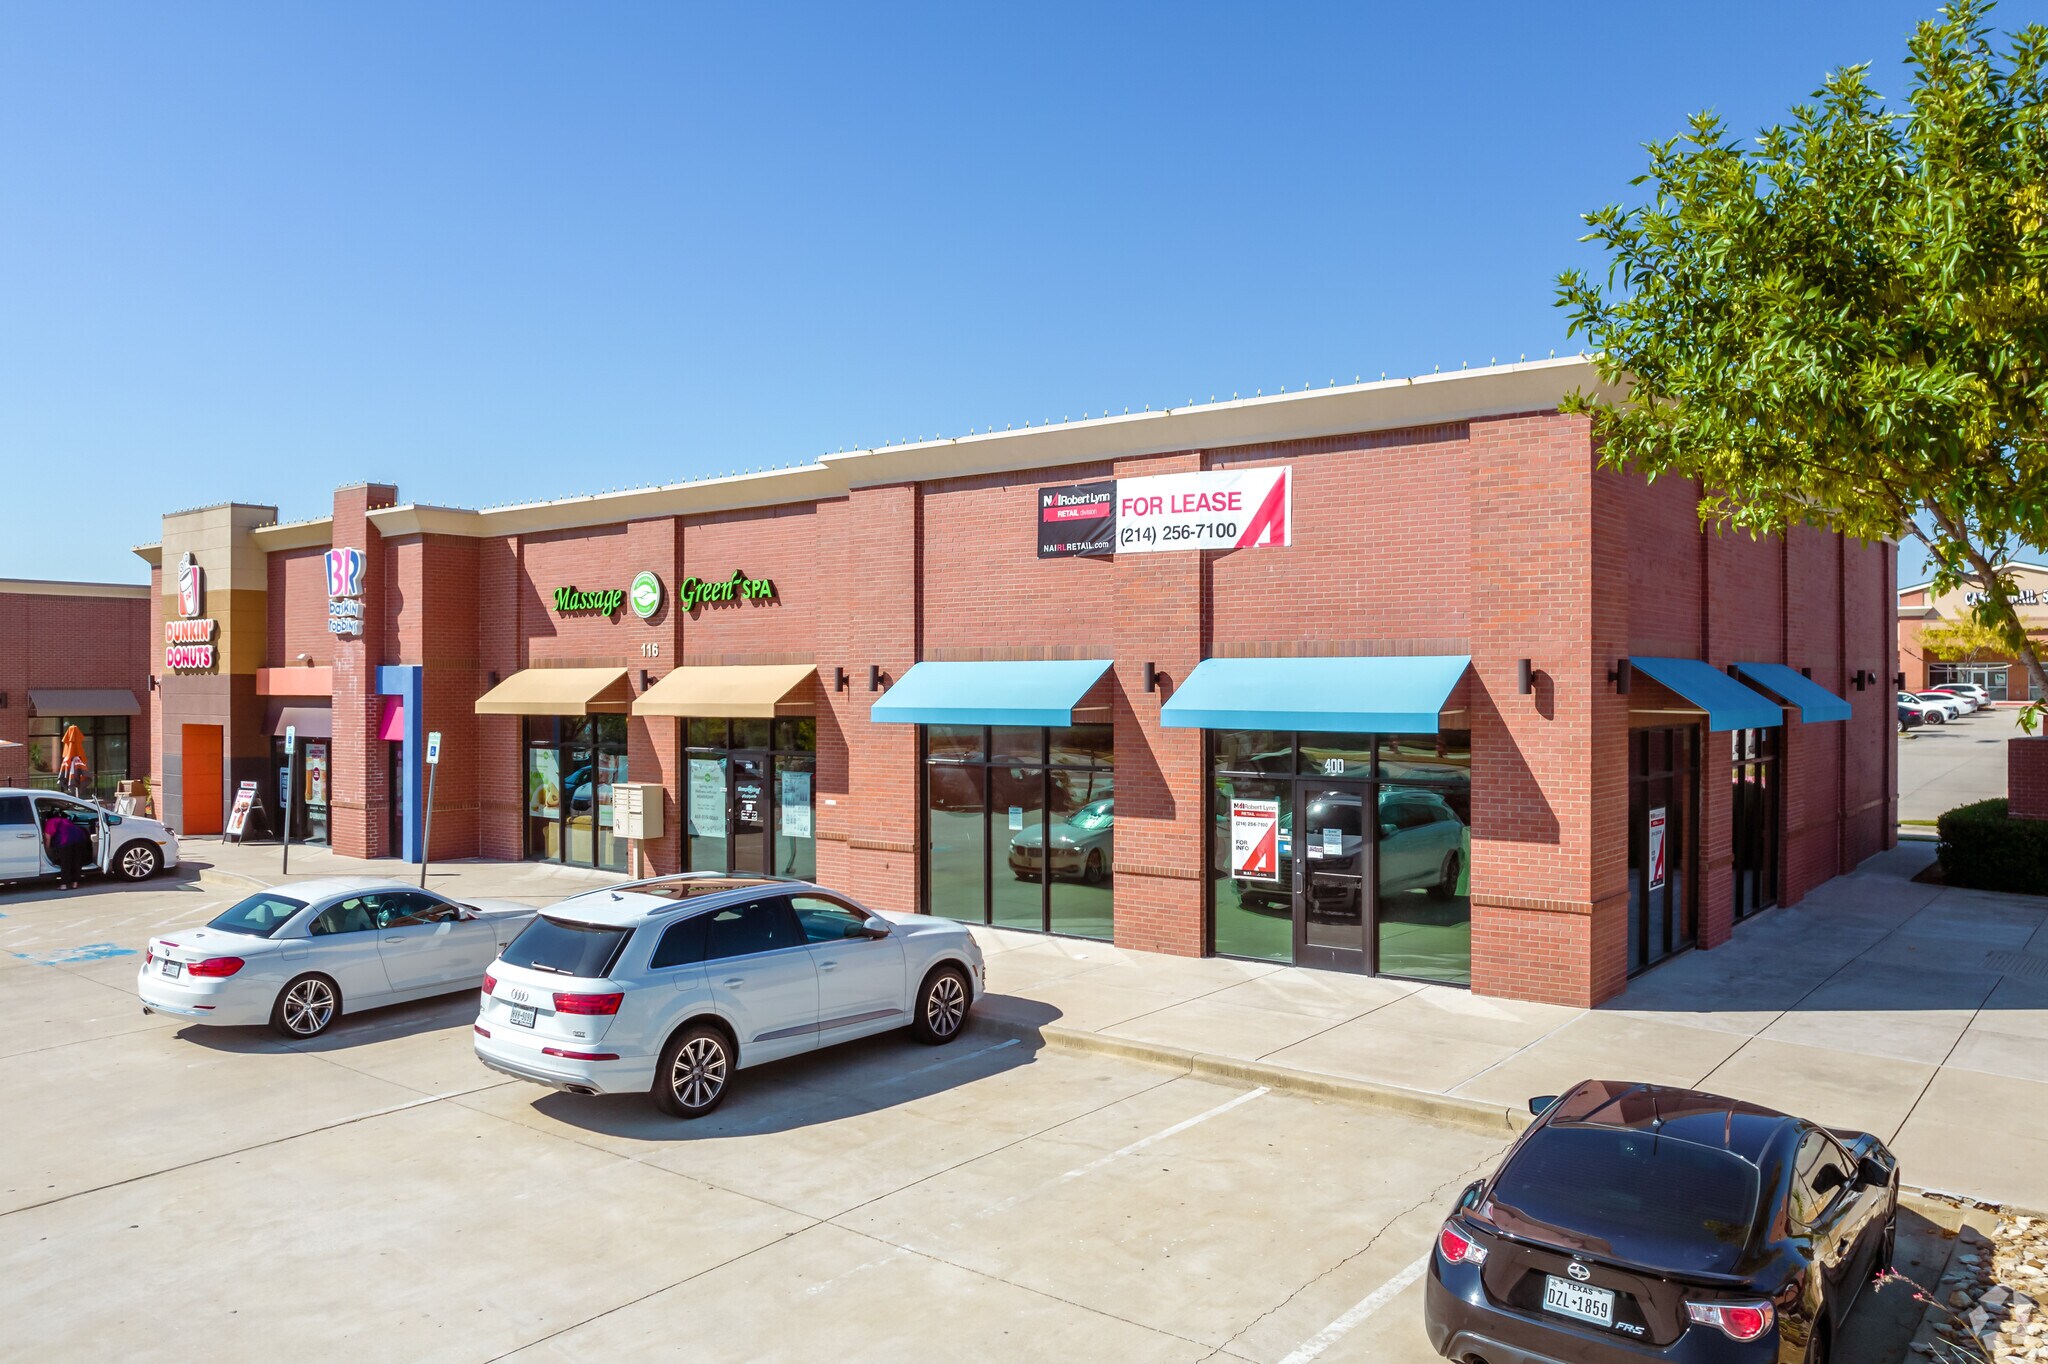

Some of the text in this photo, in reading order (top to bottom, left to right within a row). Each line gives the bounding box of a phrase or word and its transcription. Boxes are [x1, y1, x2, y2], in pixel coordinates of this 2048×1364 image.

[1091, 493, 1110, 505] Lynn
[1122, 491, 1242, 517] FOR LEASE
[1058, 508, 1098, 518] RETAIL division
[1120, 523, 1237, 546] (214) 256-7100
[1043, 541, 1109, 553] NAIRLRETAIL.com
[552, 587, 622, 617] Massage
[680, 576, 736, 612] Green
[742, 579, 772, 599] SPA
[166, 620, 214, 643] DUNKIN'
[166, 645, 212, 668] DONUTS
[640, 643, 659, 657] 116
[1324, 758, 1345, 774] 400
[1567, 1282, 1594, 1296] TEXAS
